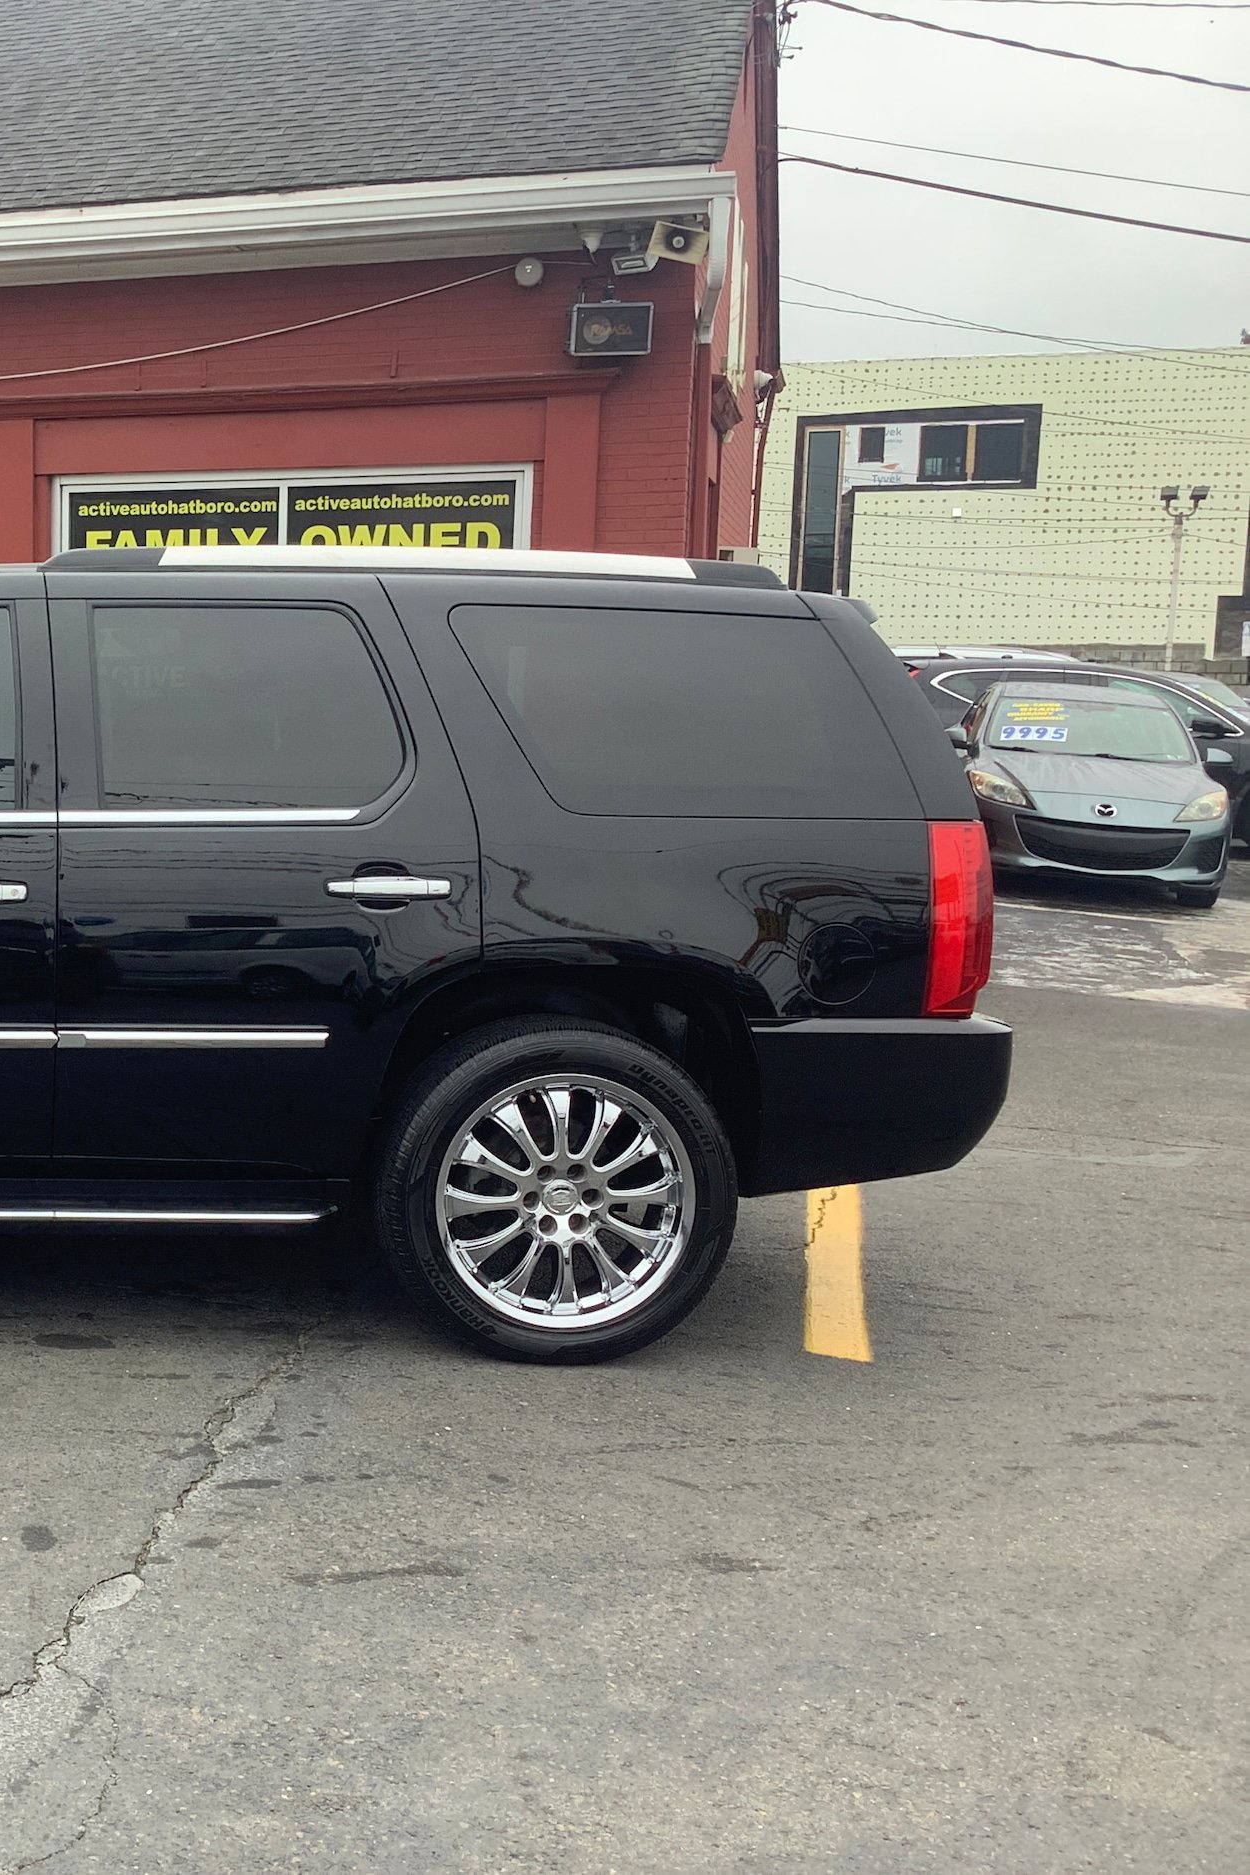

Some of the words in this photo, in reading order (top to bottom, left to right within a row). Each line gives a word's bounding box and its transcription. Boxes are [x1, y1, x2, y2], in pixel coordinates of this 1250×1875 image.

[872, 474, 902, 486] Tyvek
[78, 498, 277, 517] activeautohatboro.com
[294, 493, 510, 511] activeautohatboro.com
[300, 522, 501, 549] OWNED
[1002, 726, 1066, 740] 9995
